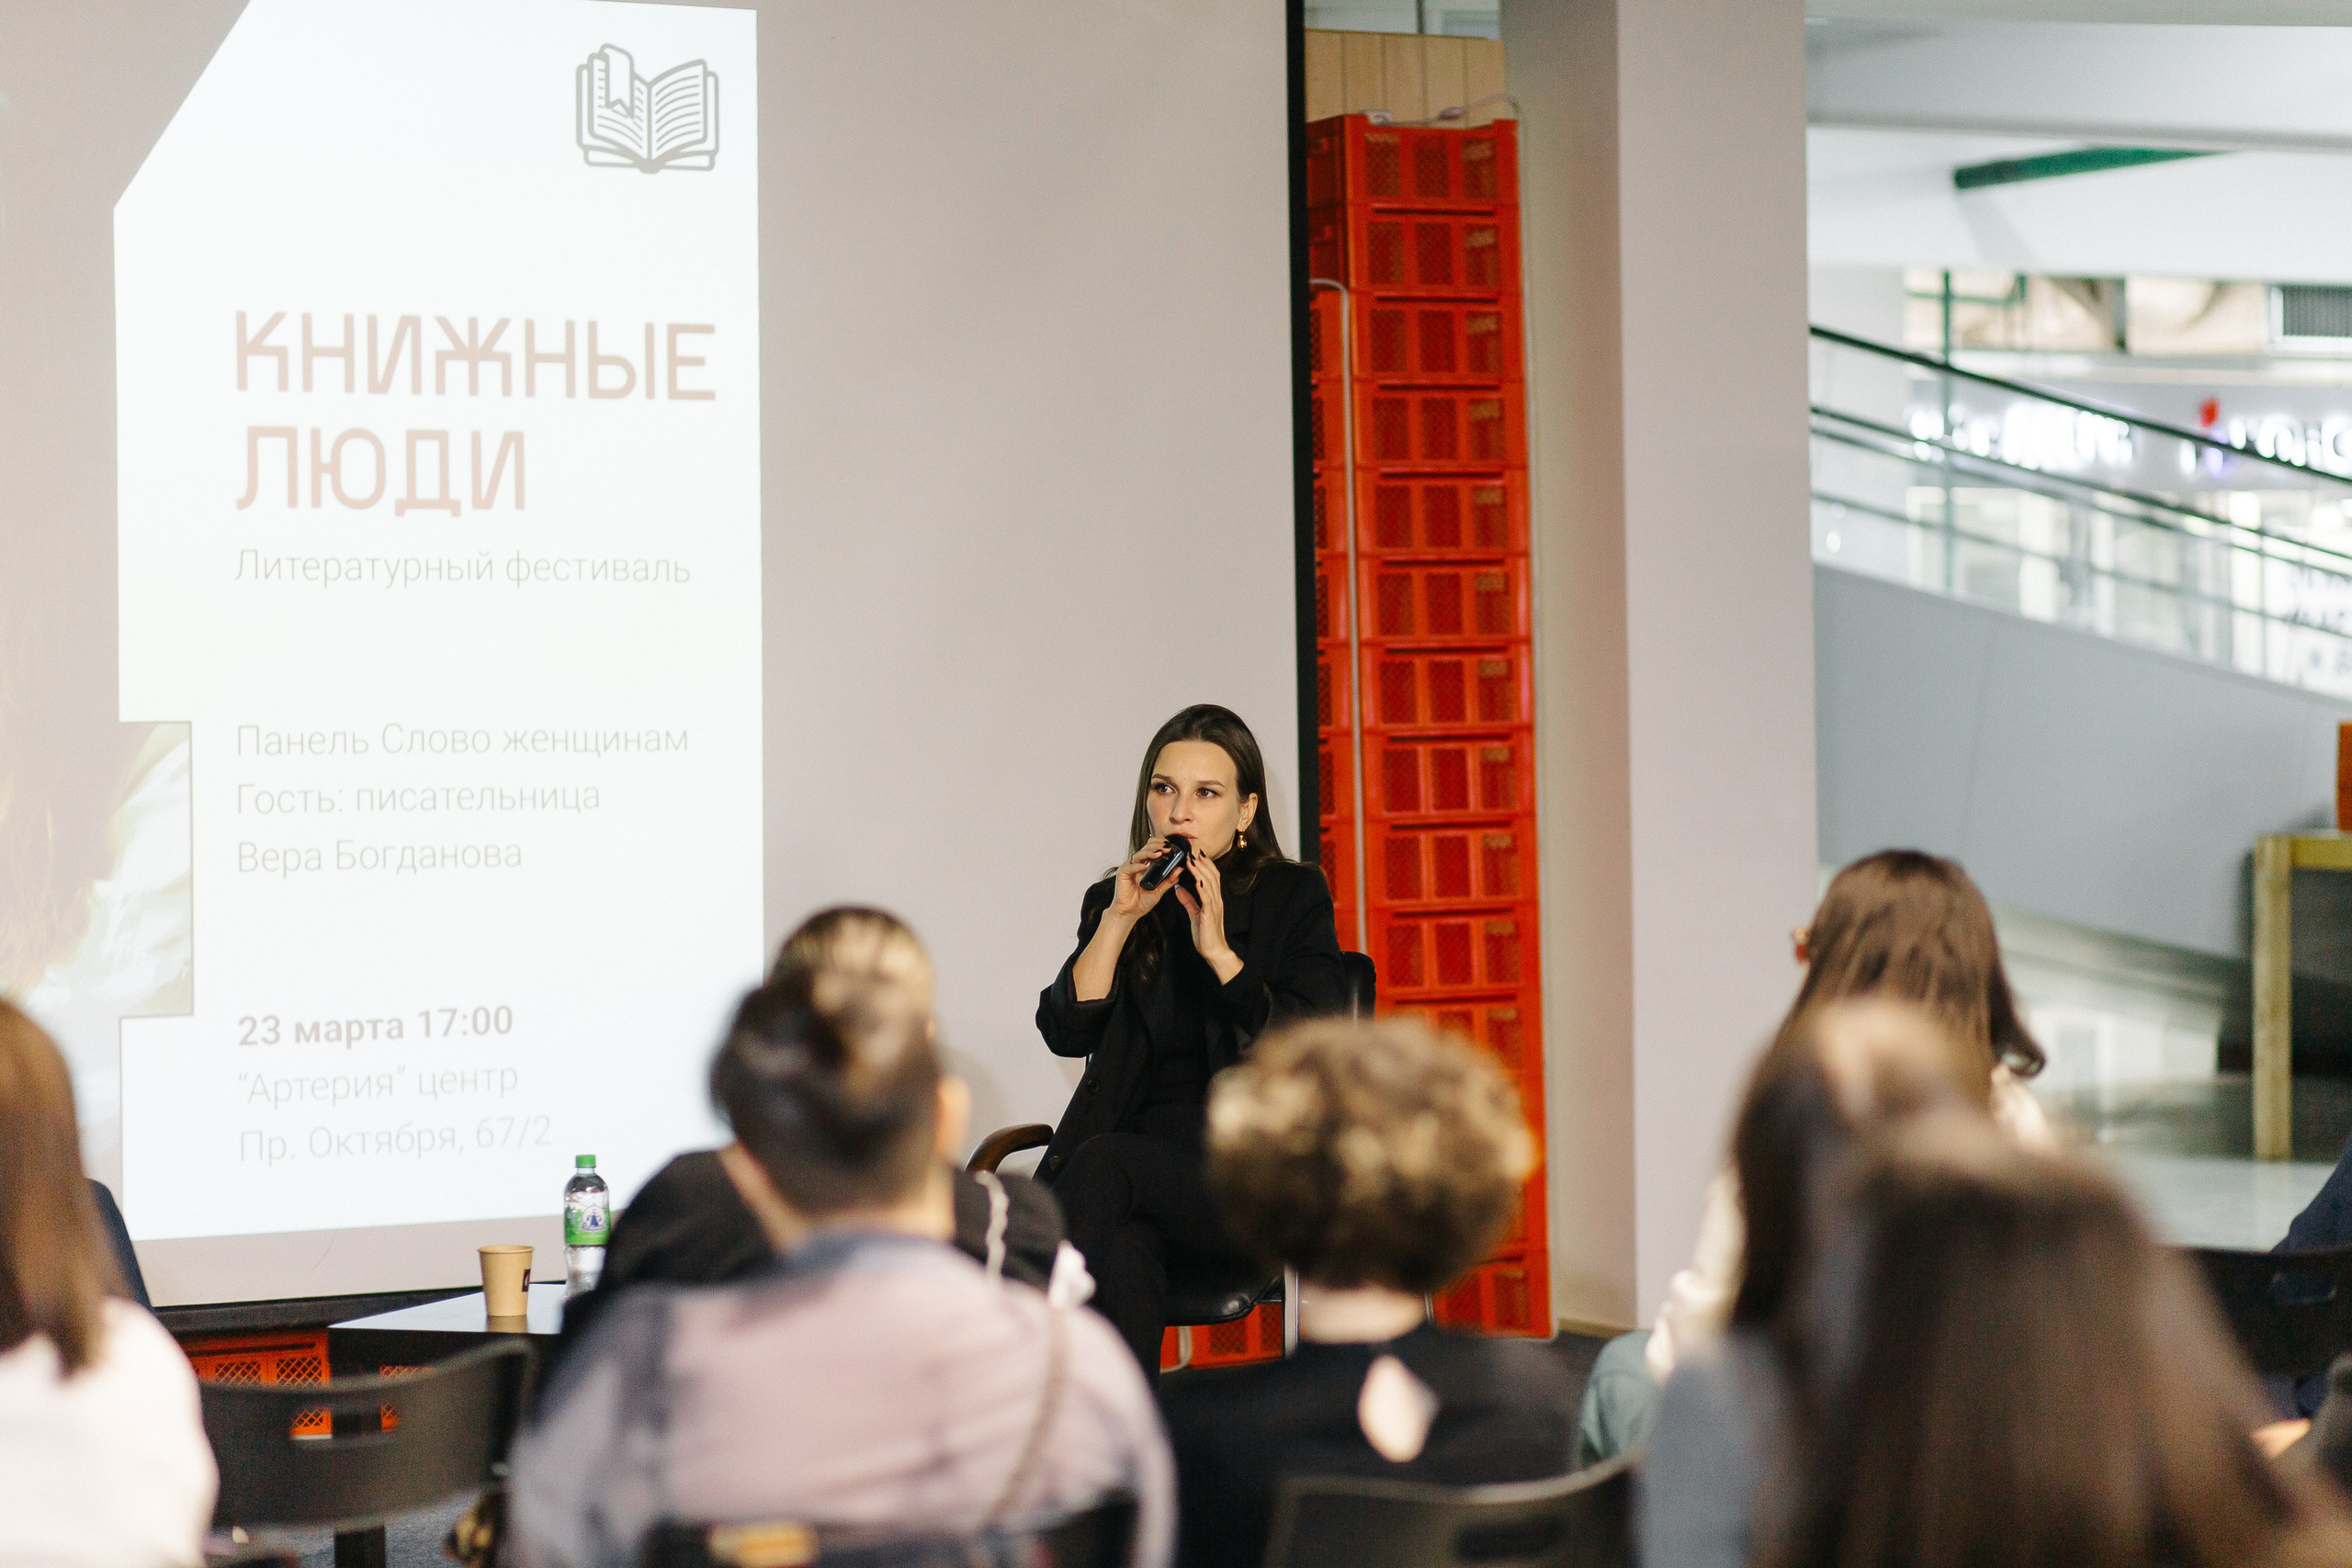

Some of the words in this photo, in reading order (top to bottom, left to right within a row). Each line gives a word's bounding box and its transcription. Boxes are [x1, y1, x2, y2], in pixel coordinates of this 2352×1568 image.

[235, 310, 717, 401] КНИЖНЫЕ
[235, 424, 526, 518] ЛЮДИ
[234, 547, 495, 590] Литературный
[504, 549, 692, 590] фестиваль
[236, 723, 370, 757] Панель
[380, 721, 492, 755] Слово
[502, 727, 689, 759] женщинам
[236, 782, 344, 816] Гость:
[356, 784, 601, 815] писательница
[237, 840, 322, 880] Вера
[334, 838, 523, 875] Богданова
[238, 1014, 282, 1047] 23
[294, 1016, 404, 1050] марта
[418, 1004, 514, 1038] 17:00
[417, 1066, 519, 1101] центр
[239, 1129, 296, 1168] Пр.
[308, 1120, 464, 1160] Октября,
[475, 1112, 553, 1150] 67/2
